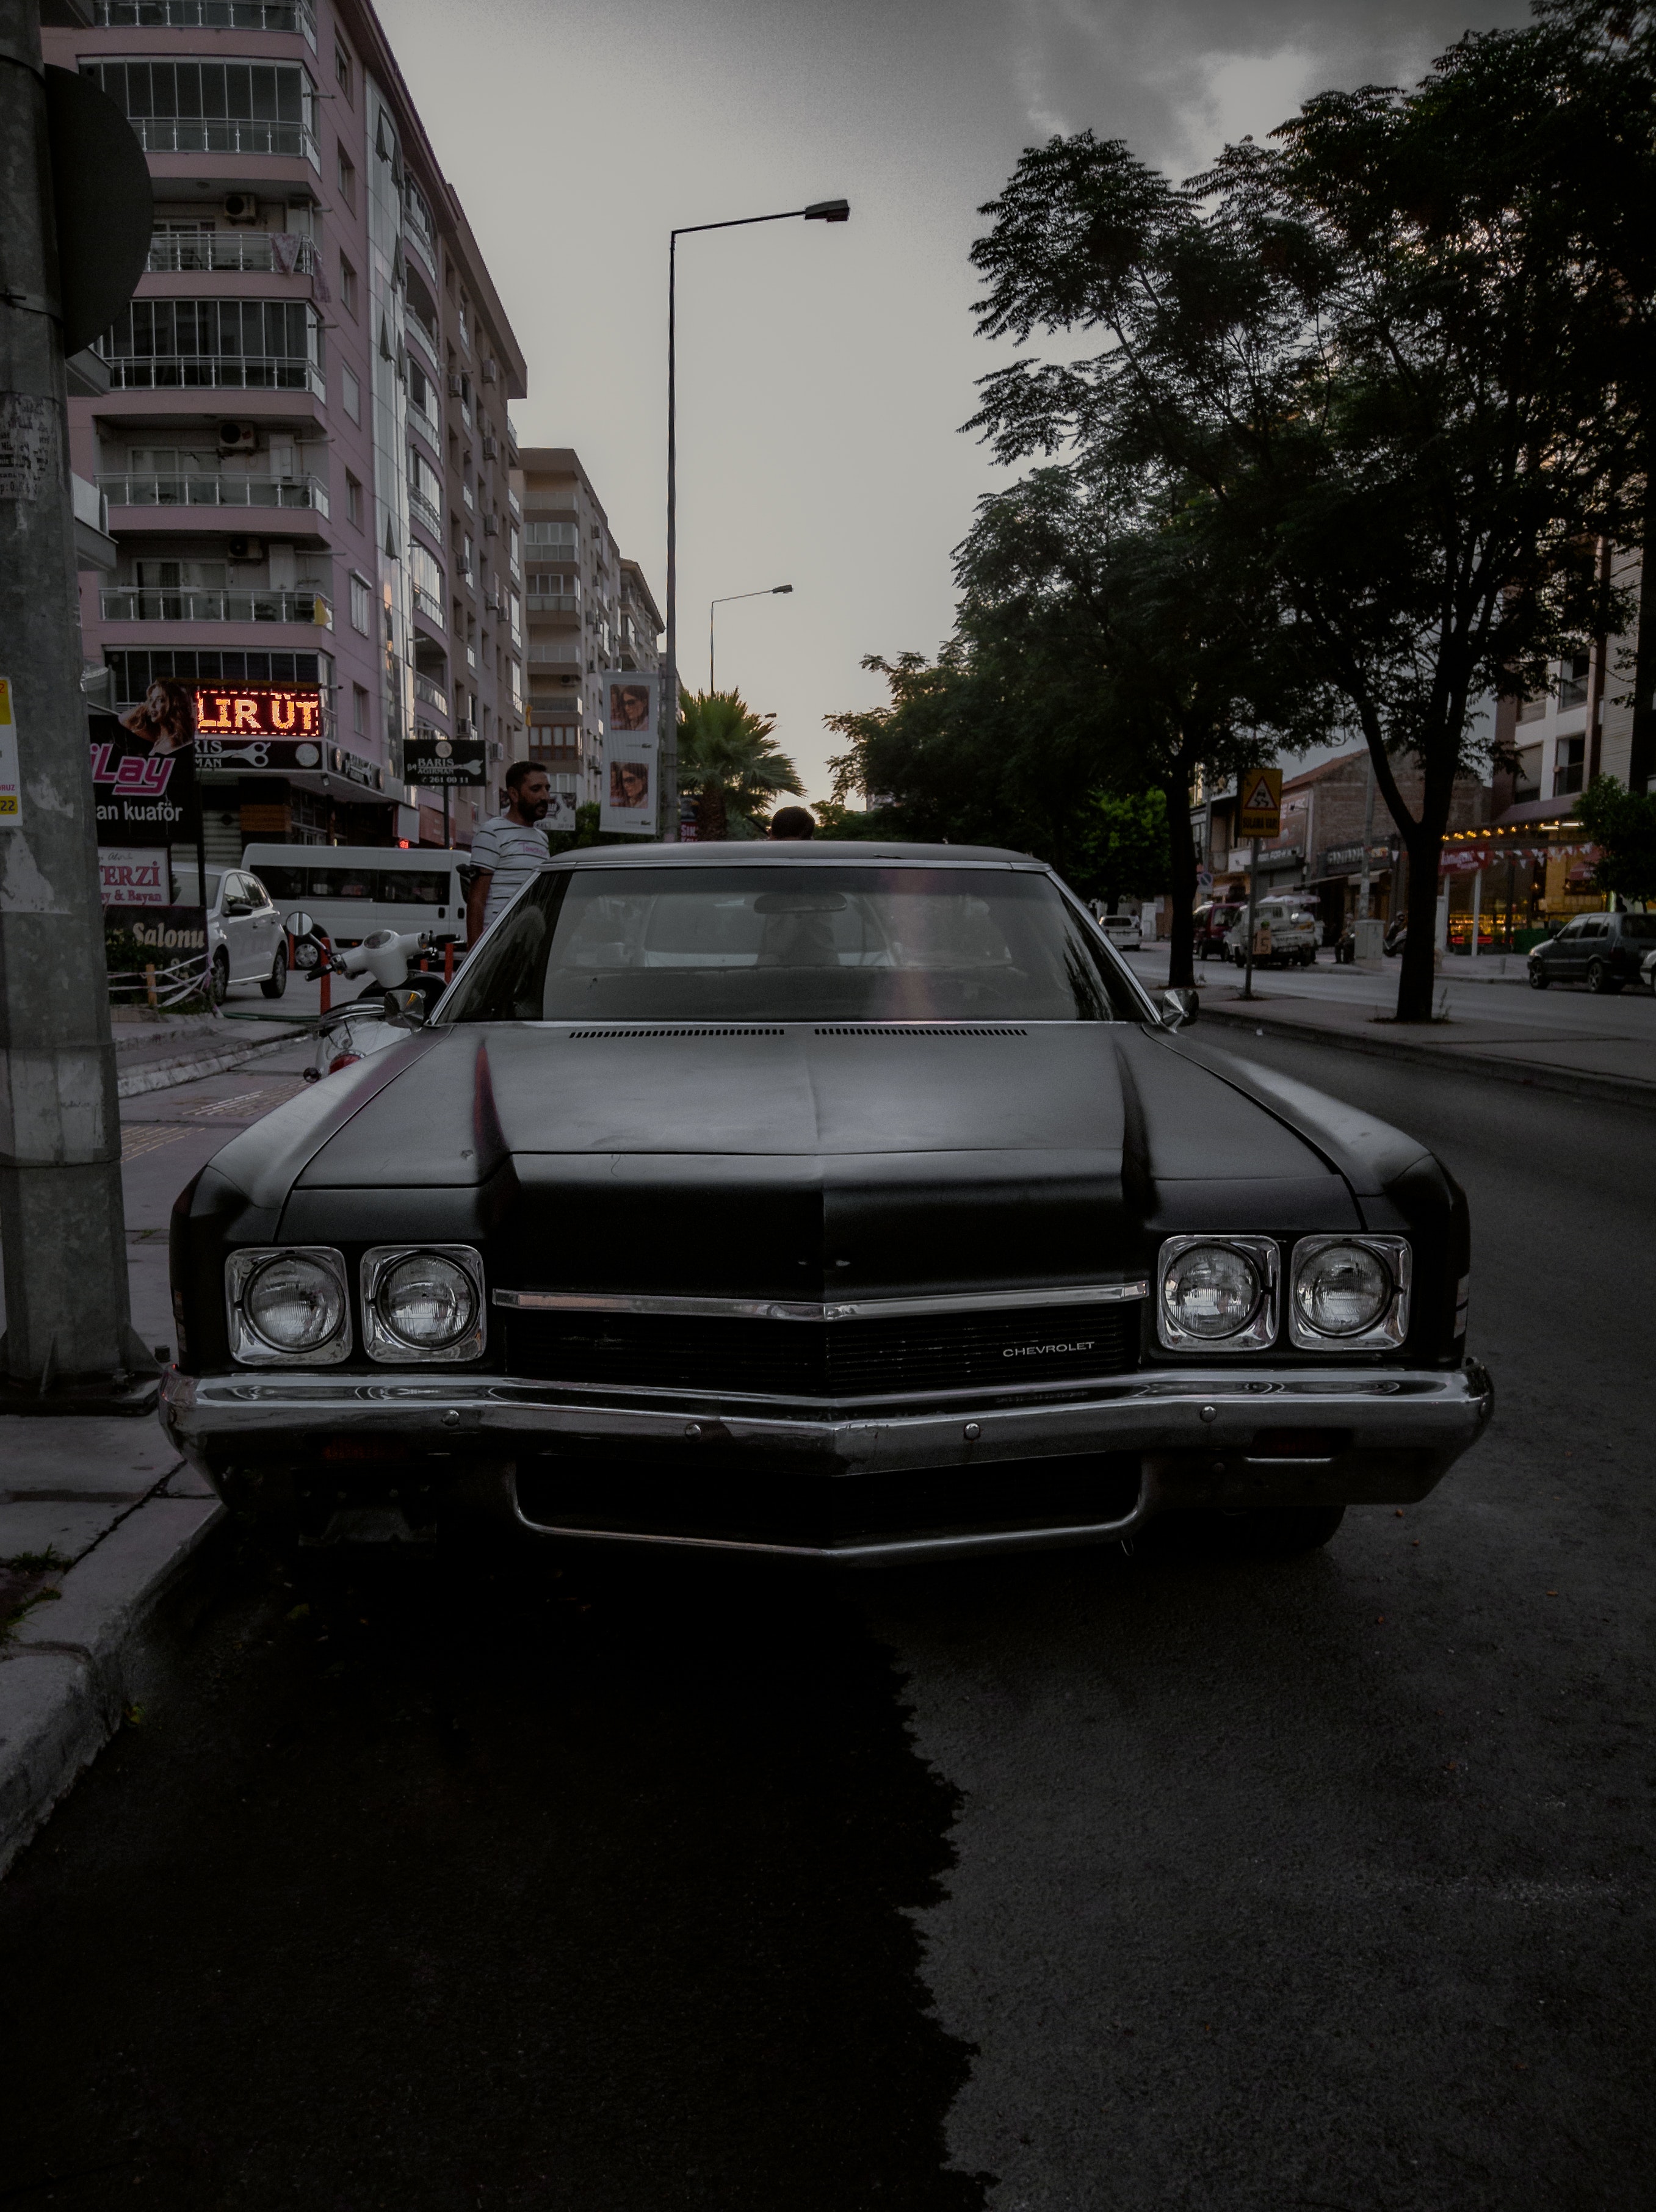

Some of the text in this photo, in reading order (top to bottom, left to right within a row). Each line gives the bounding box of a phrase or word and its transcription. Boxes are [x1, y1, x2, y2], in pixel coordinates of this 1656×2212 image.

[272, 693, 318, 730] ÜT
[96, 800, 183, 822] an kuaför
[114, 889, 125, 901] &
[128, 889, 162, 904] Bayan
[132, 922, 206, 949] Salonu
[1002, 1341, 1096, 1357] CHEVROLET
